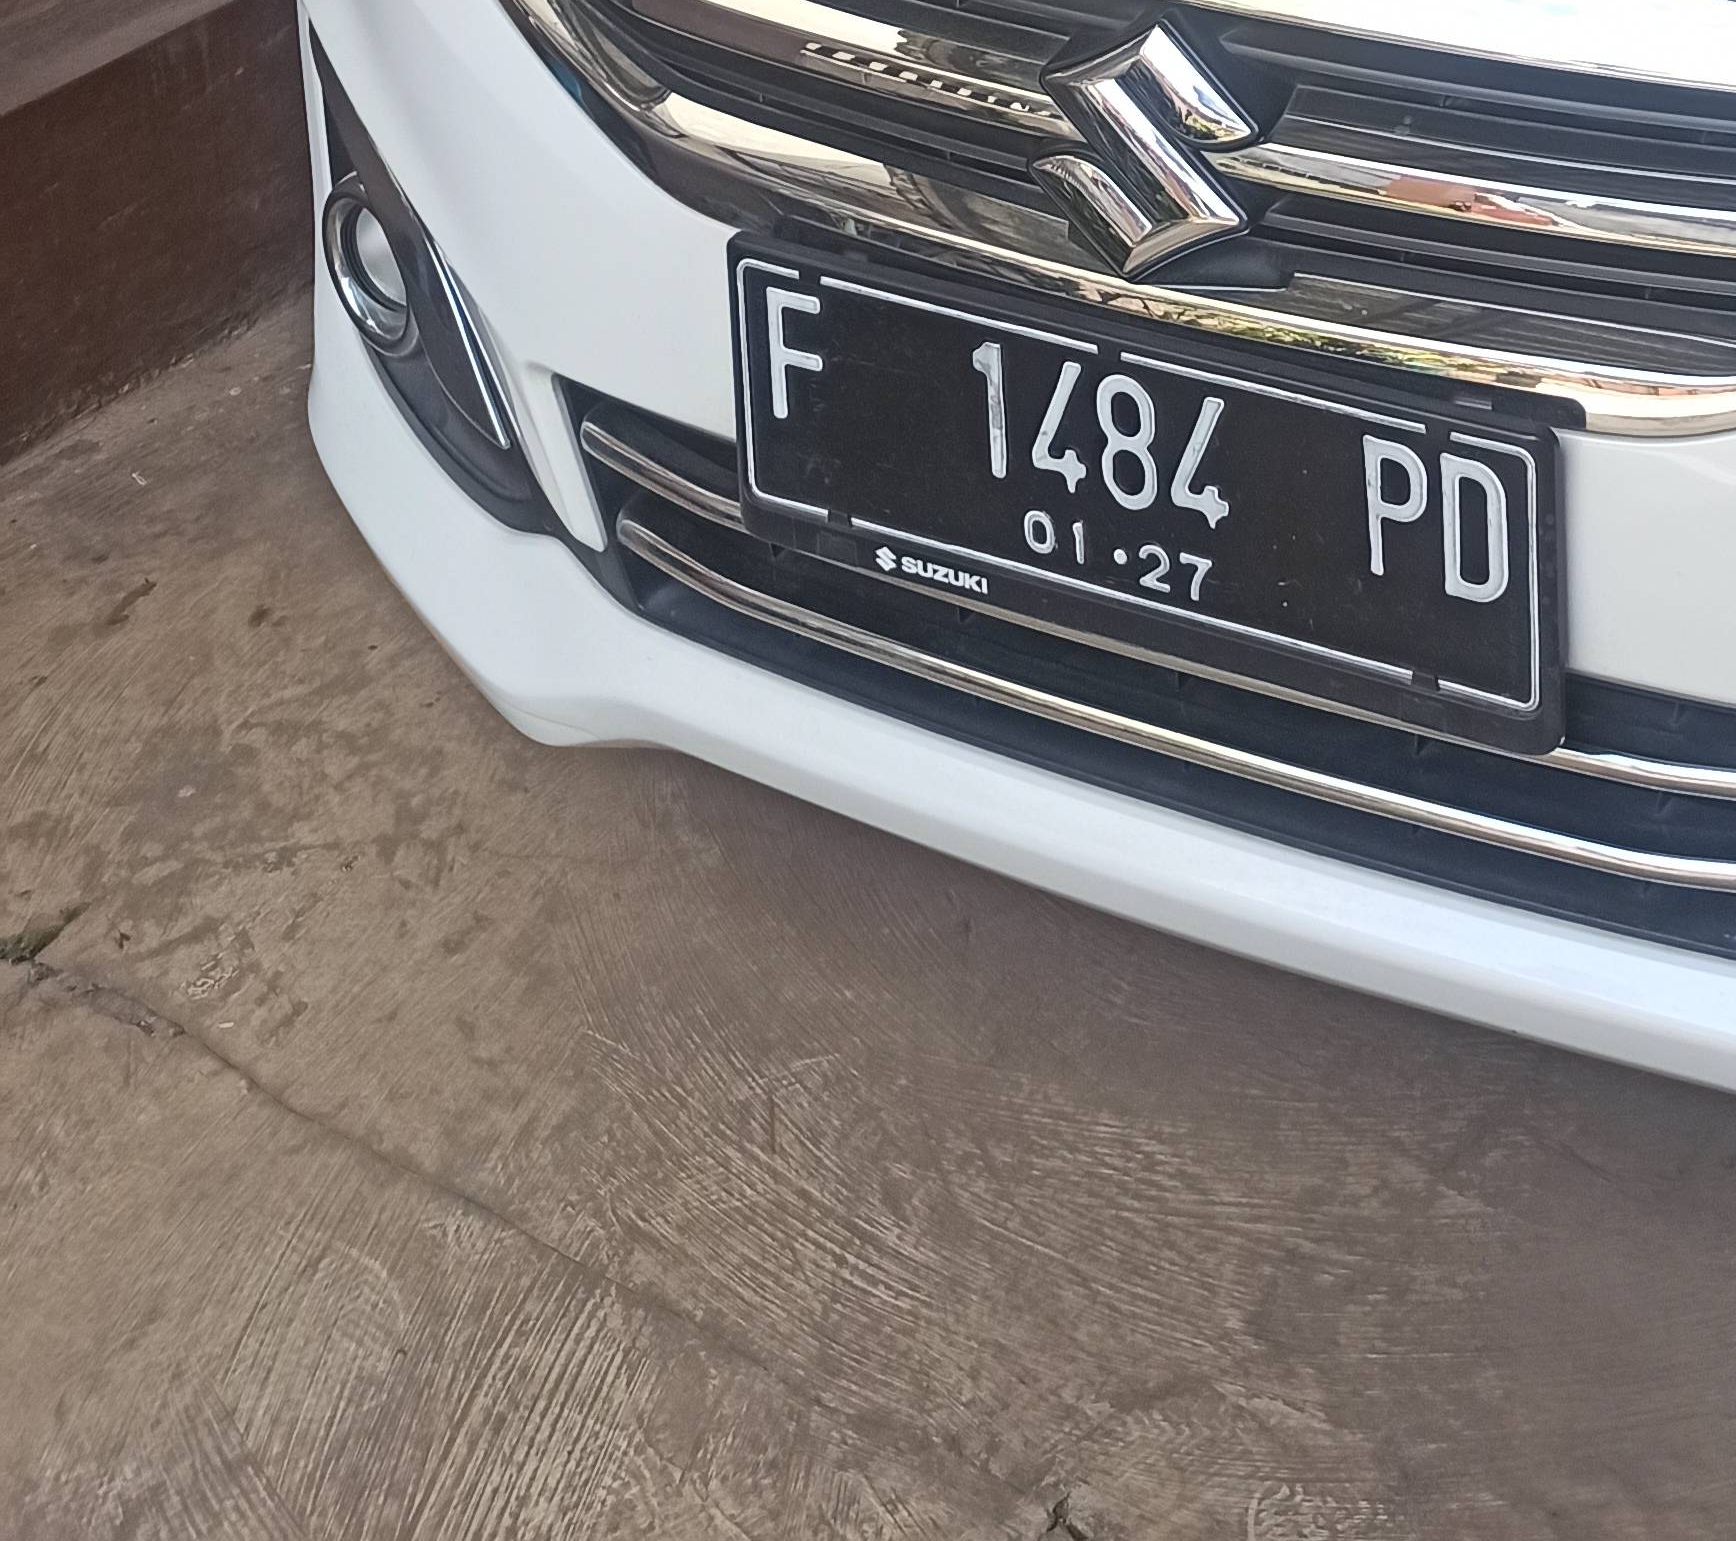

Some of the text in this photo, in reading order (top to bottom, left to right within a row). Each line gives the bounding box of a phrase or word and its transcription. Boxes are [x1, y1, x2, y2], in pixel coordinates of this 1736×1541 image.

[765, 286, 1509, 604] F 1484 PD
[901, 555, 988, 595] SUZUKI
